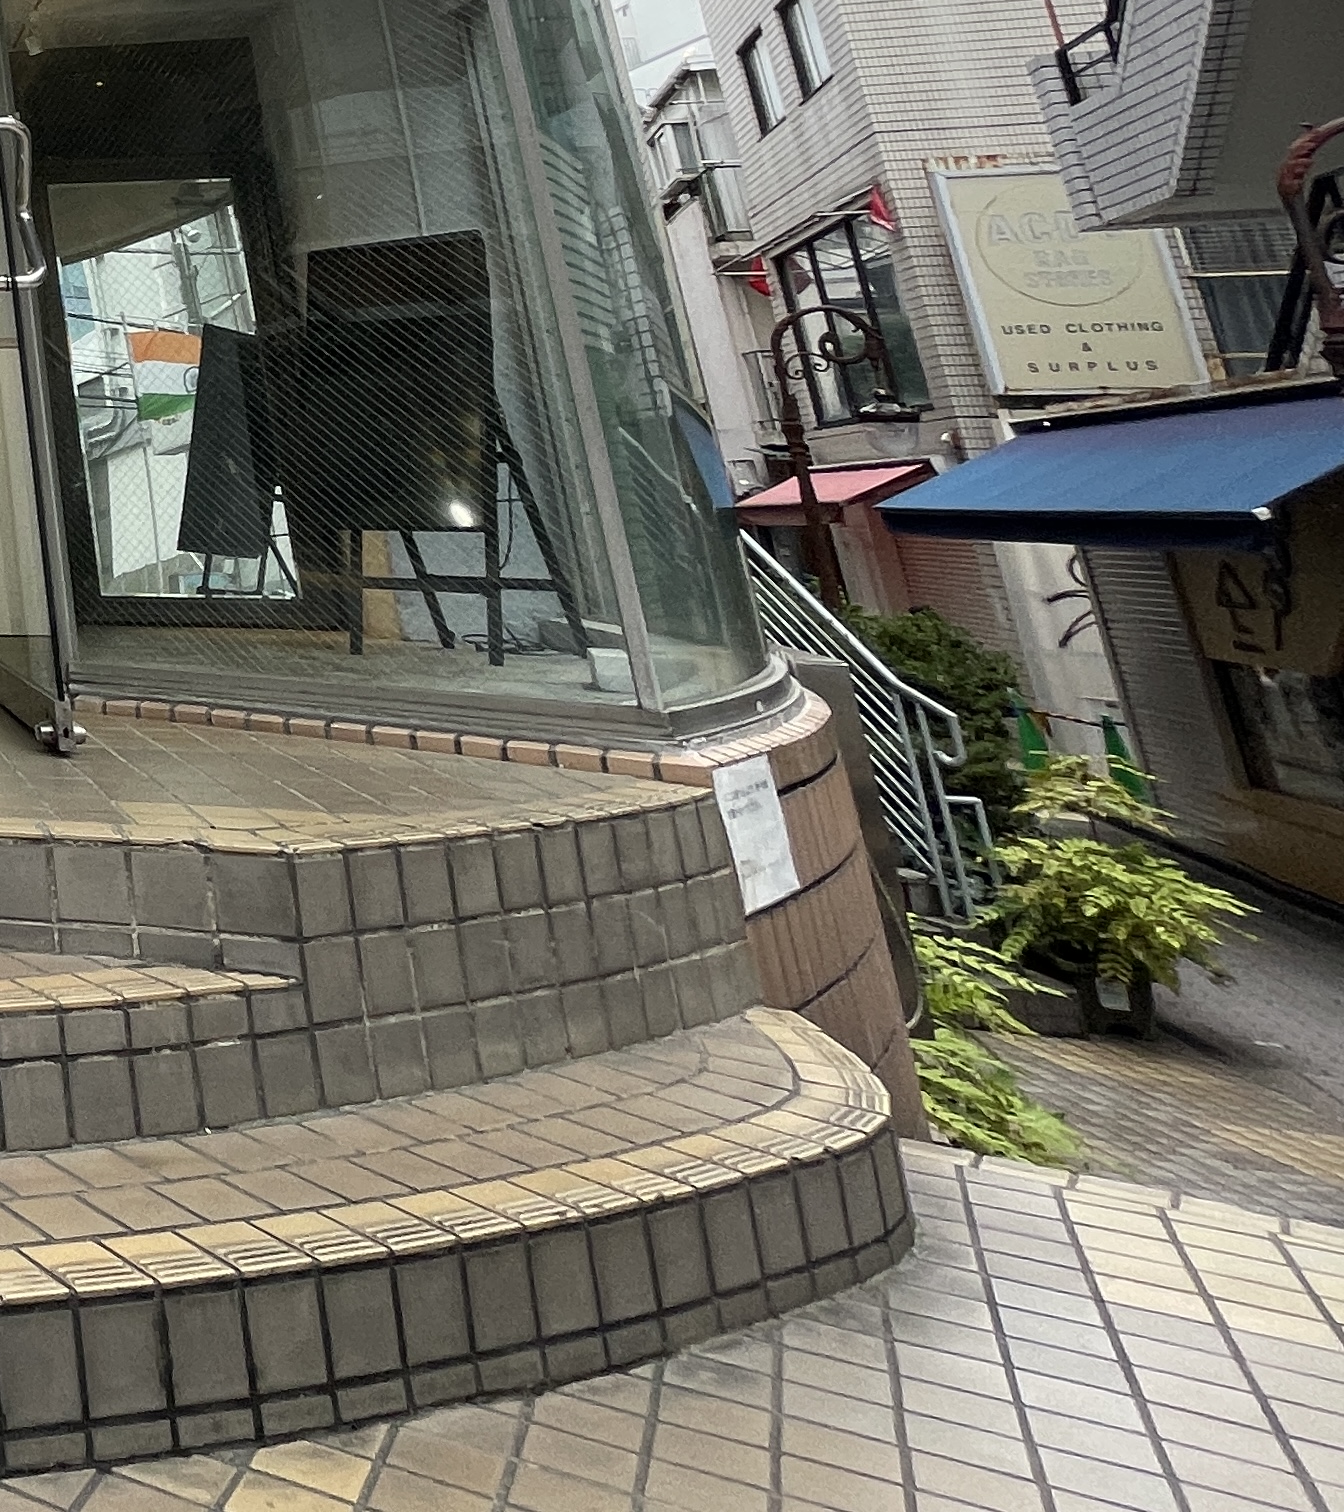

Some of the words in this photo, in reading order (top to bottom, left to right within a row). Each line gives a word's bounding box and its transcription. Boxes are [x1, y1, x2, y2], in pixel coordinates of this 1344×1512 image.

[1001, 324, 1051, 335] USED
[1065, 321, 1164, 334] CLOTHING
[1027, 360, 1159, 373] SURPLUS
